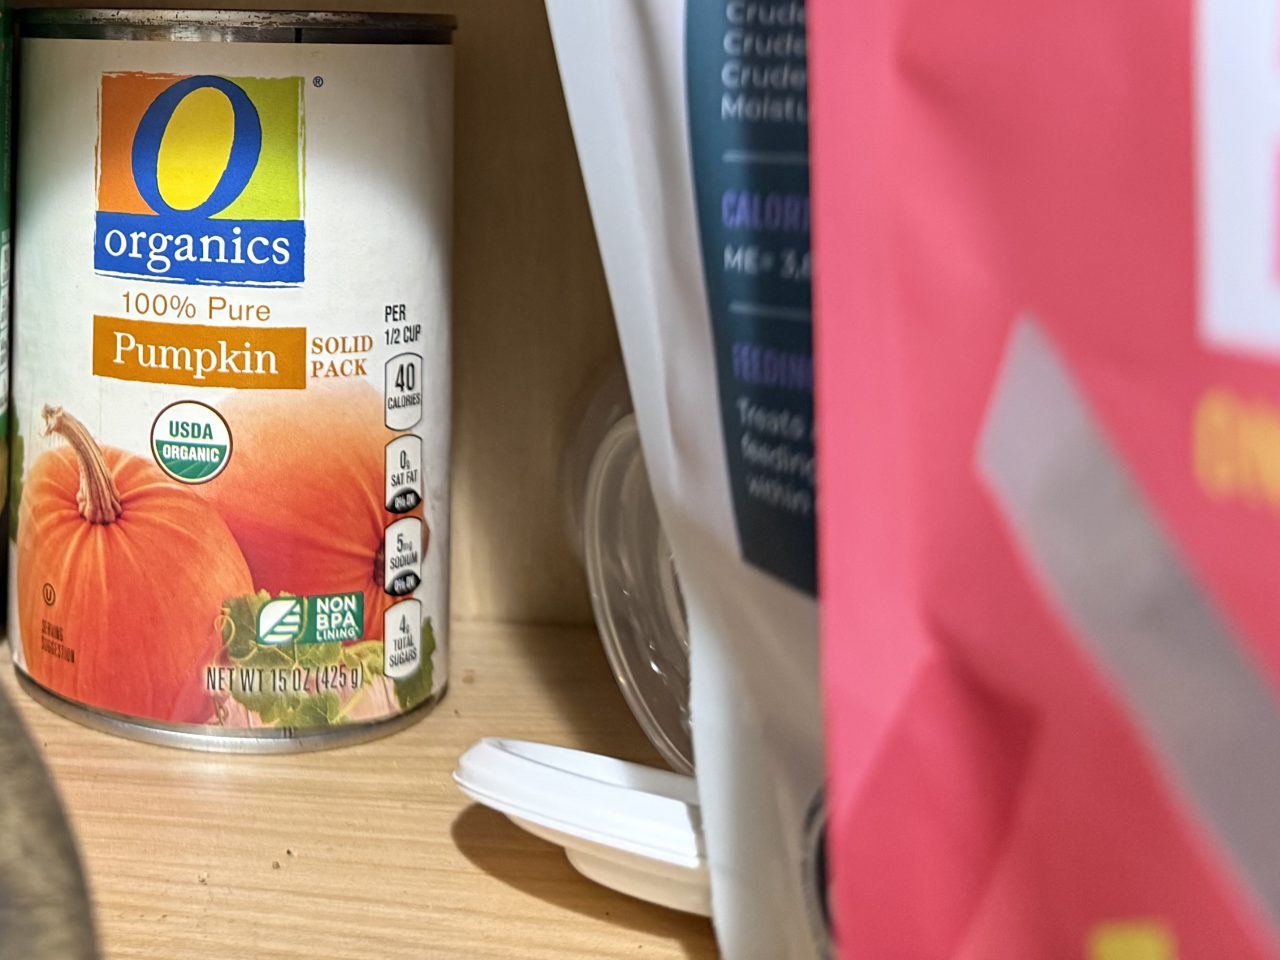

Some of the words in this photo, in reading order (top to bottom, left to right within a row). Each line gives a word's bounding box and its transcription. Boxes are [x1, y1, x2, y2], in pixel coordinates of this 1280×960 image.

[104, 226, 291, 274] organics
[121, 291, 197, 319] 100%
[208, 295, 272, 322] Pure
[384, 304, 406, 322] PER
[384, 326, 401, 346] 1/2
[403, 323, 422, 344] CUP
[113, 331, 279, 380] Pumpkin
[311, 335, 374, 356] SOLID
[311, 358, 368, 378] PACK
[395, 362, 416, 392] 40
[387, 392, 421, 410] CALORIES
[169, 420, 214, 440] USDA
[162, 444, 220, 463] ORGANIC
[391, 471, 405, 487] SAT
[406, 469, 418, 484] FAT
[389, 552, 418, 571] SODIUM
[316, 594, 357, 614] NON
[316, 611, 358, 631] BPA
[316, 627, 357, 641] LINING
[393, 633, 414, 652] TOTAL
[389, 647, 417, 668] SUGARS
[206, 666, 235, 692] NET
[240, 665, 265, 693] WT
[272, 666, 288, 693] 15
[292, 665, 311, 692] OZ
[315, 663, 349, 693] (425
[351, 660, 365, 690] g)
